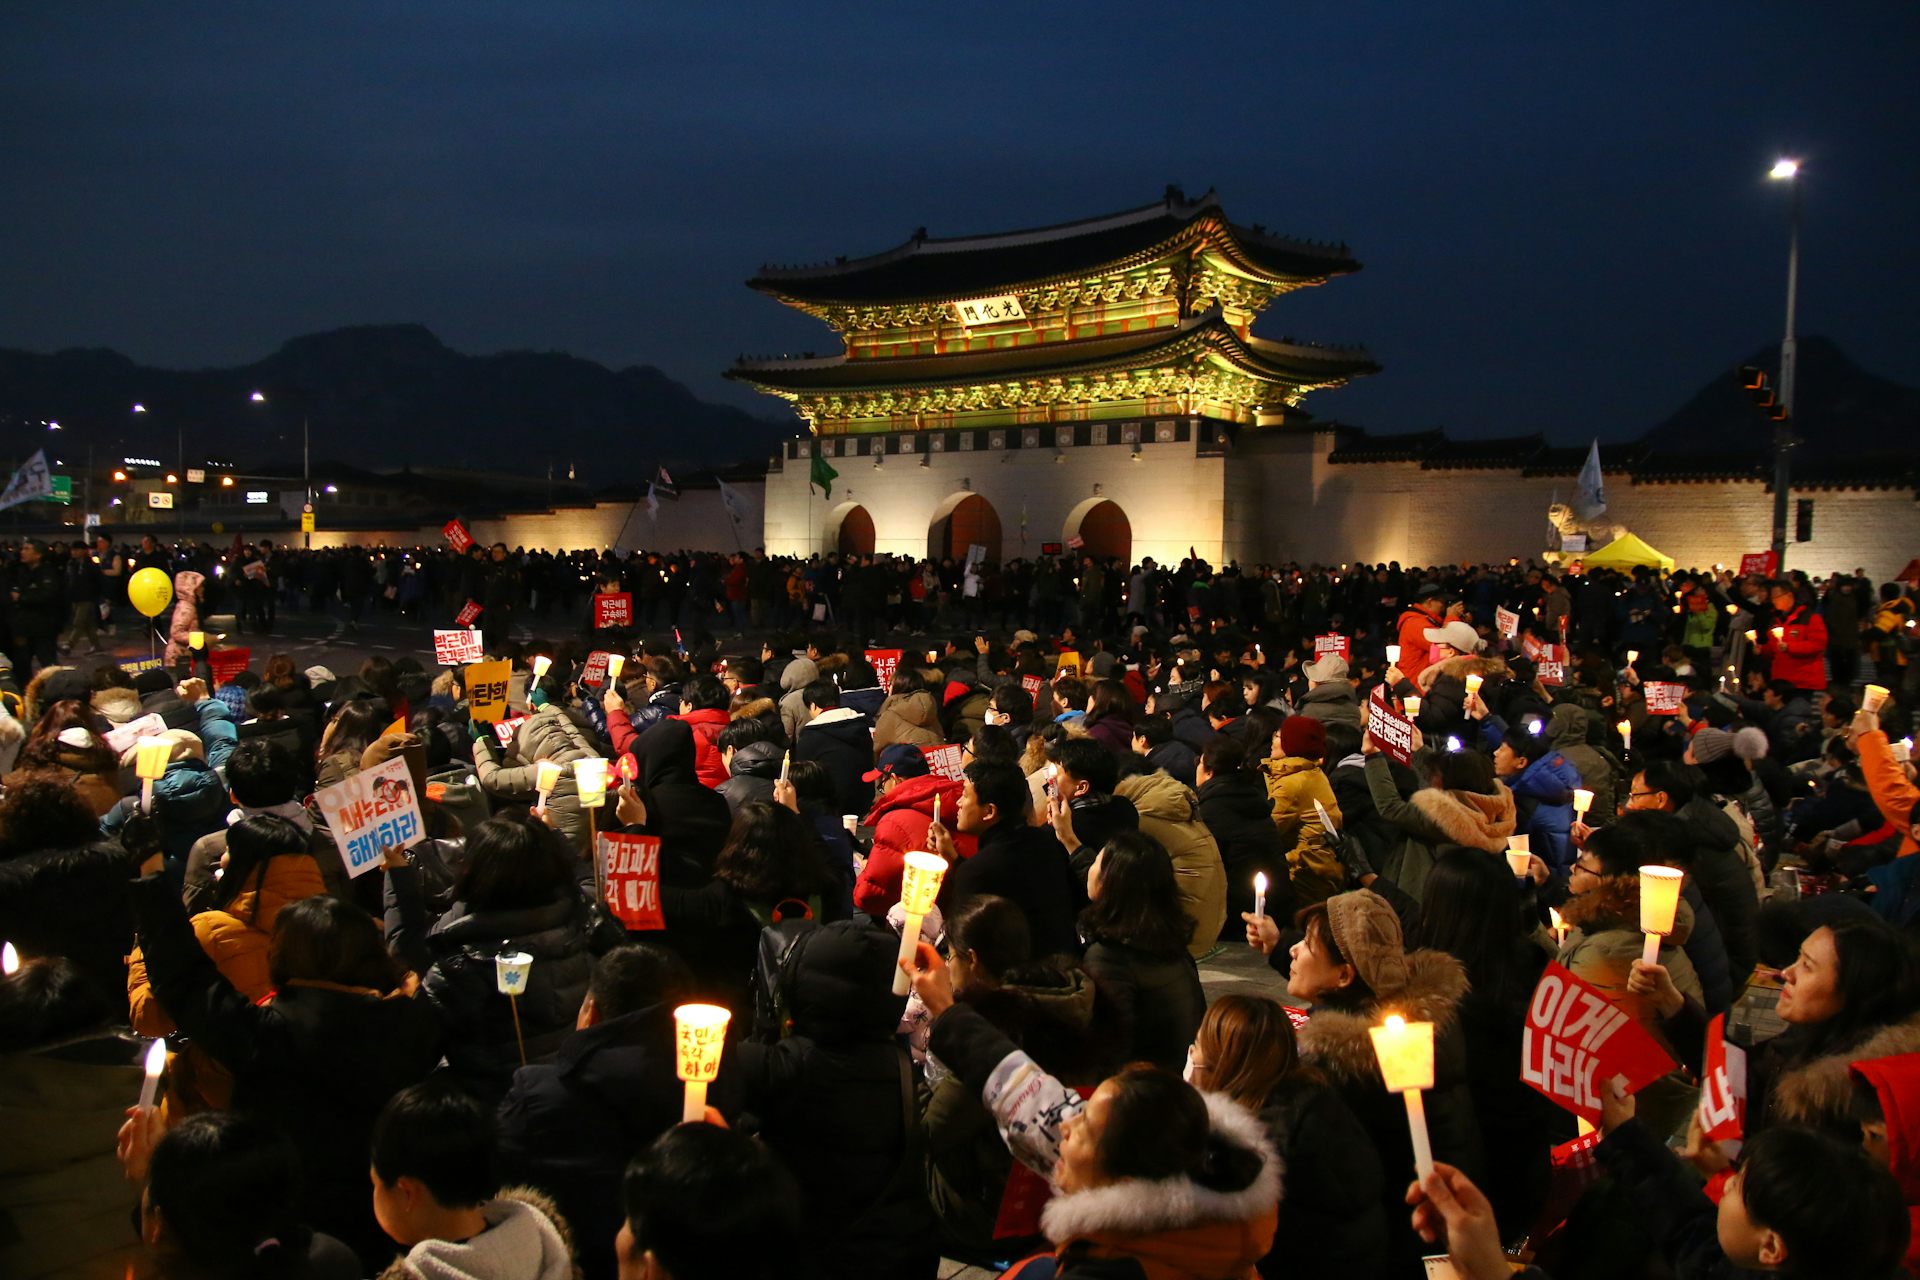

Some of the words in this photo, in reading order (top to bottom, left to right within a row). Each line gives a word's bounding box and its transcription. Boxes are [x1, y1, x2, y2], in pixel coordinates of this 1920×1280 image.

[601, 599, 627, 609] 박근혜를
[601, 609, 627, 620] 구속하라
[434, 630, 474, 650] 박근혜
[1315, 636, 1345, 652] 재벌도
[436, 645, 484, 664] 즉각퇴진
[1537, 660, 1564, 683] 퇴진
[469, 680, 508, 709] 탄핵
[347, 810, 417, 868] 해체하라
[1531, 974, 1631, 1054] 이게
[685, 1057, 717, 1078] 하야
